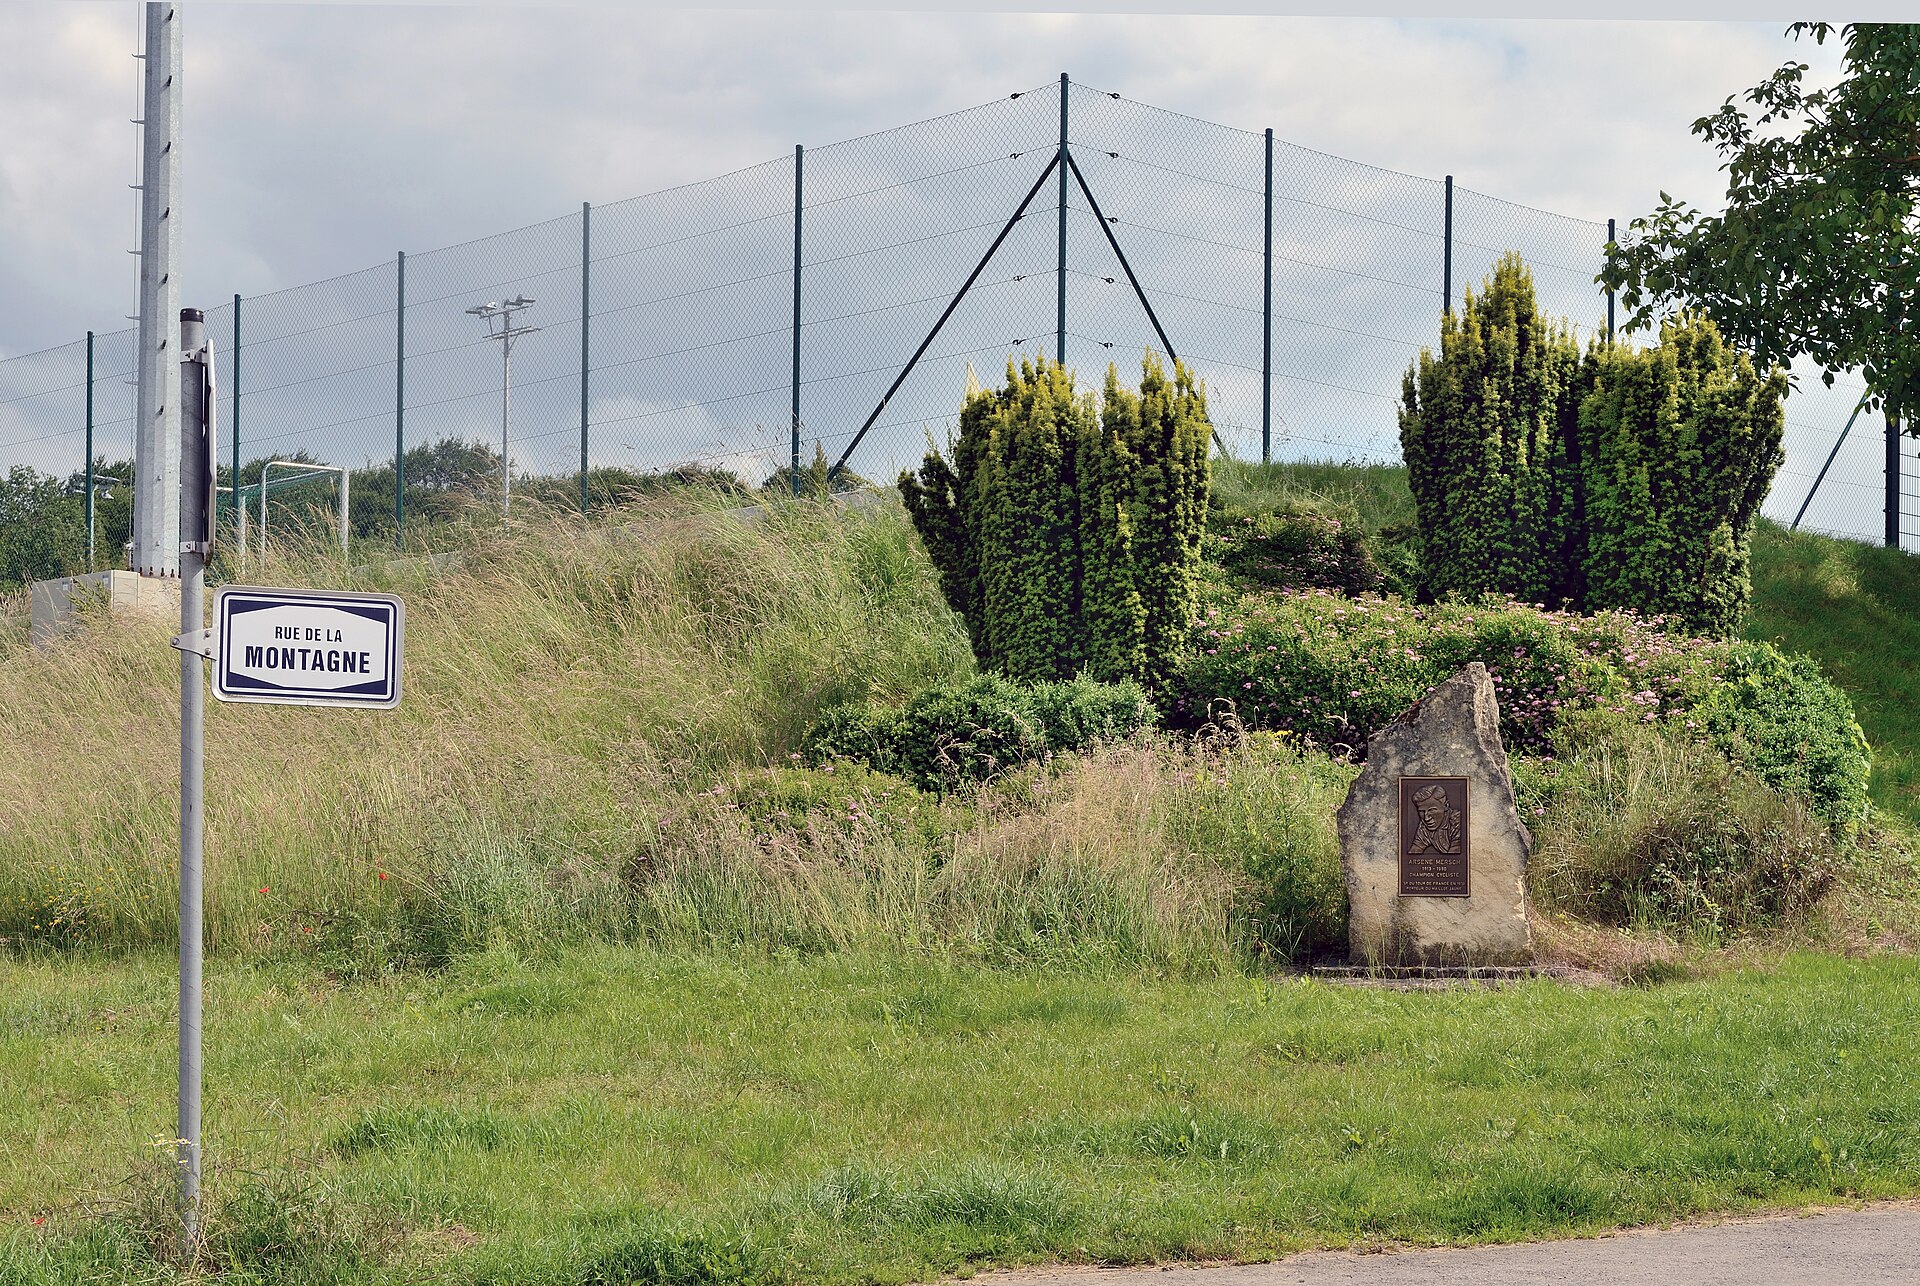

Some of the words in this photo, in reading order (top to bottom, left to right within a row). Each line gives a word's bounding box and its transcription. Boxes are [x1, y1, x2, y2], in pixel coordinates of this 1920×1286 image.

[275, 626, 300, 640] RUE
[305, 627, 321, 641] DE
[326, 629, 343, 643] LA
[245, 645, 370, 674] MONTAGNE
